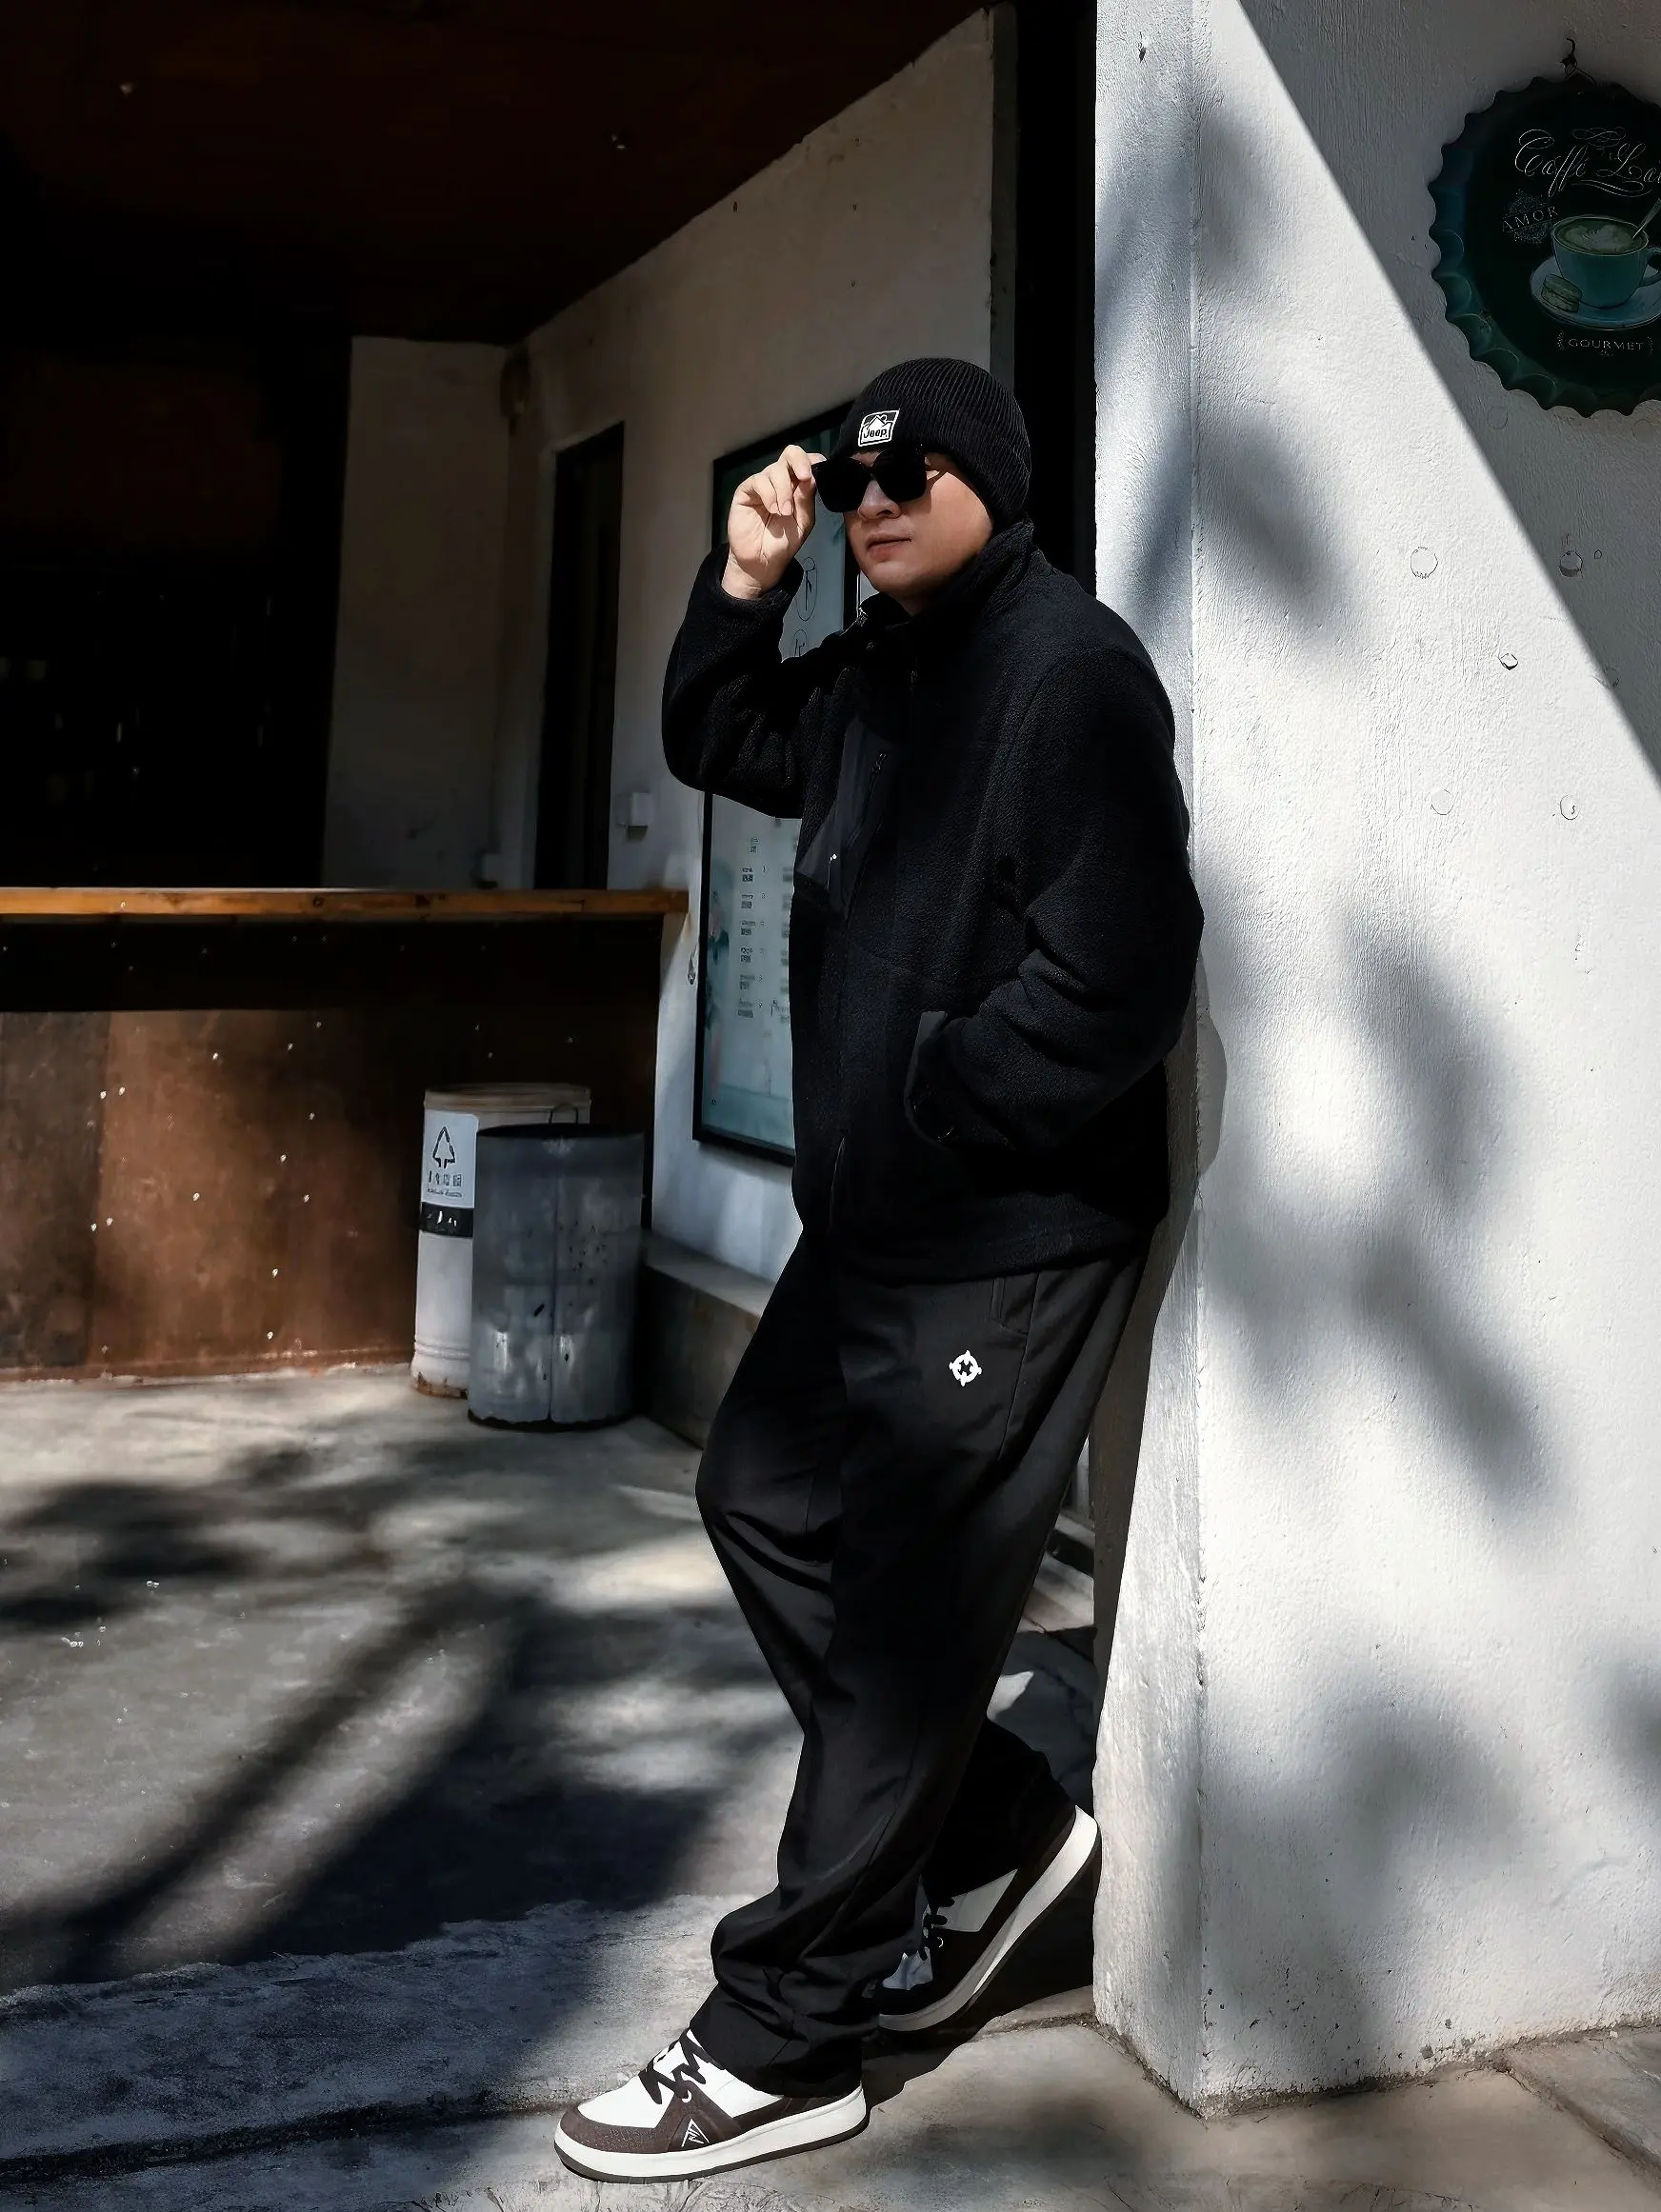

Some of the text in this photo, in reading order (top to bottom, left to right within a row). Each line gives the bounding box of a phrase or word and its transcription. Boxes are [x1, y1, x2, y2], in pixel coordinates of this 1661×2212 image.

[1501, 206, 1559, 232] AMOR
[1568, 338, 1644, 350] GOURMET
[863, 428, 887, 438] Jeep
